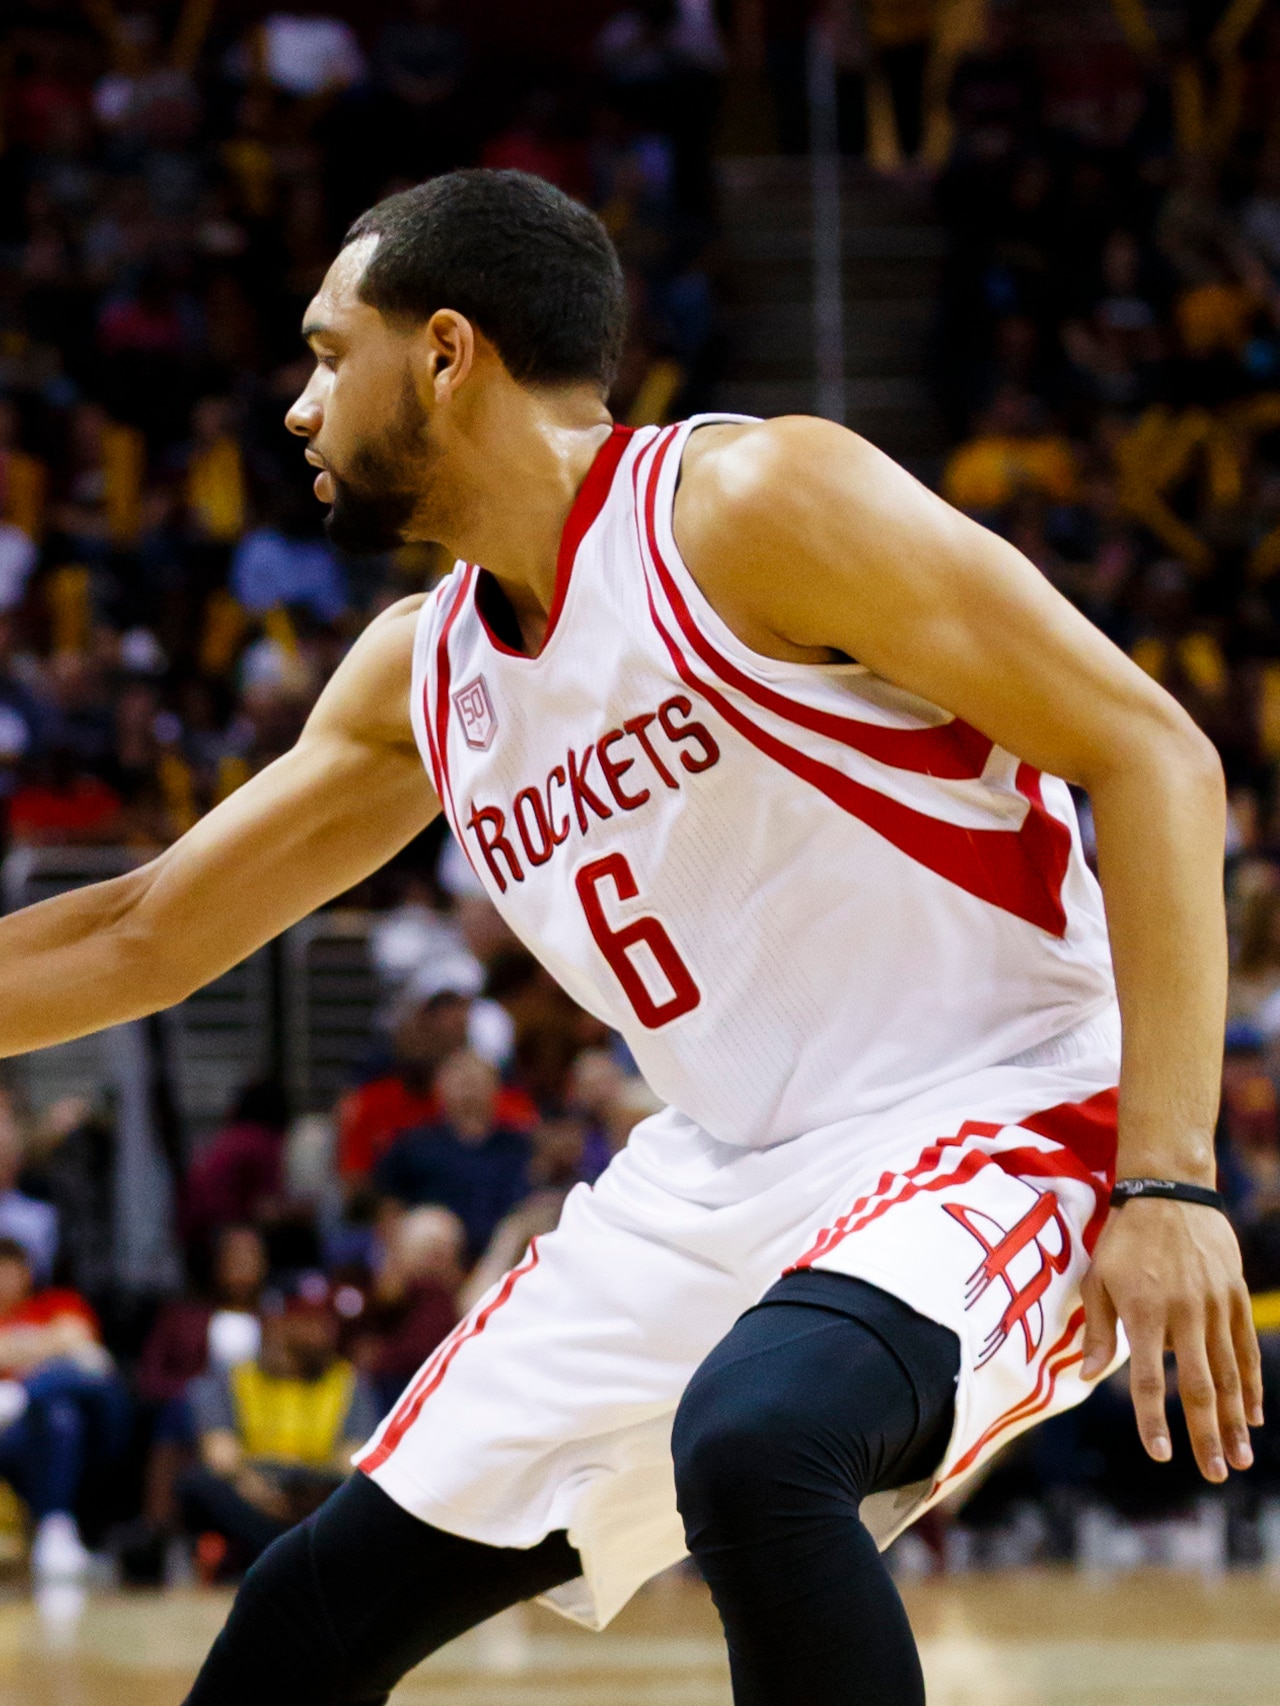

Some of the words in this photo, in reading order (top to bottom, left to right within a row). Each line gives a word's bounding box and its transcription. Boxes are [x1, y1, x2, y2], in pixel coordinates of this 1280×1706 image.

[460, 687, 484, 727] 50
[467, 695, 720, 894] ROCKETS
[575, 852, 701, 1030] 6
